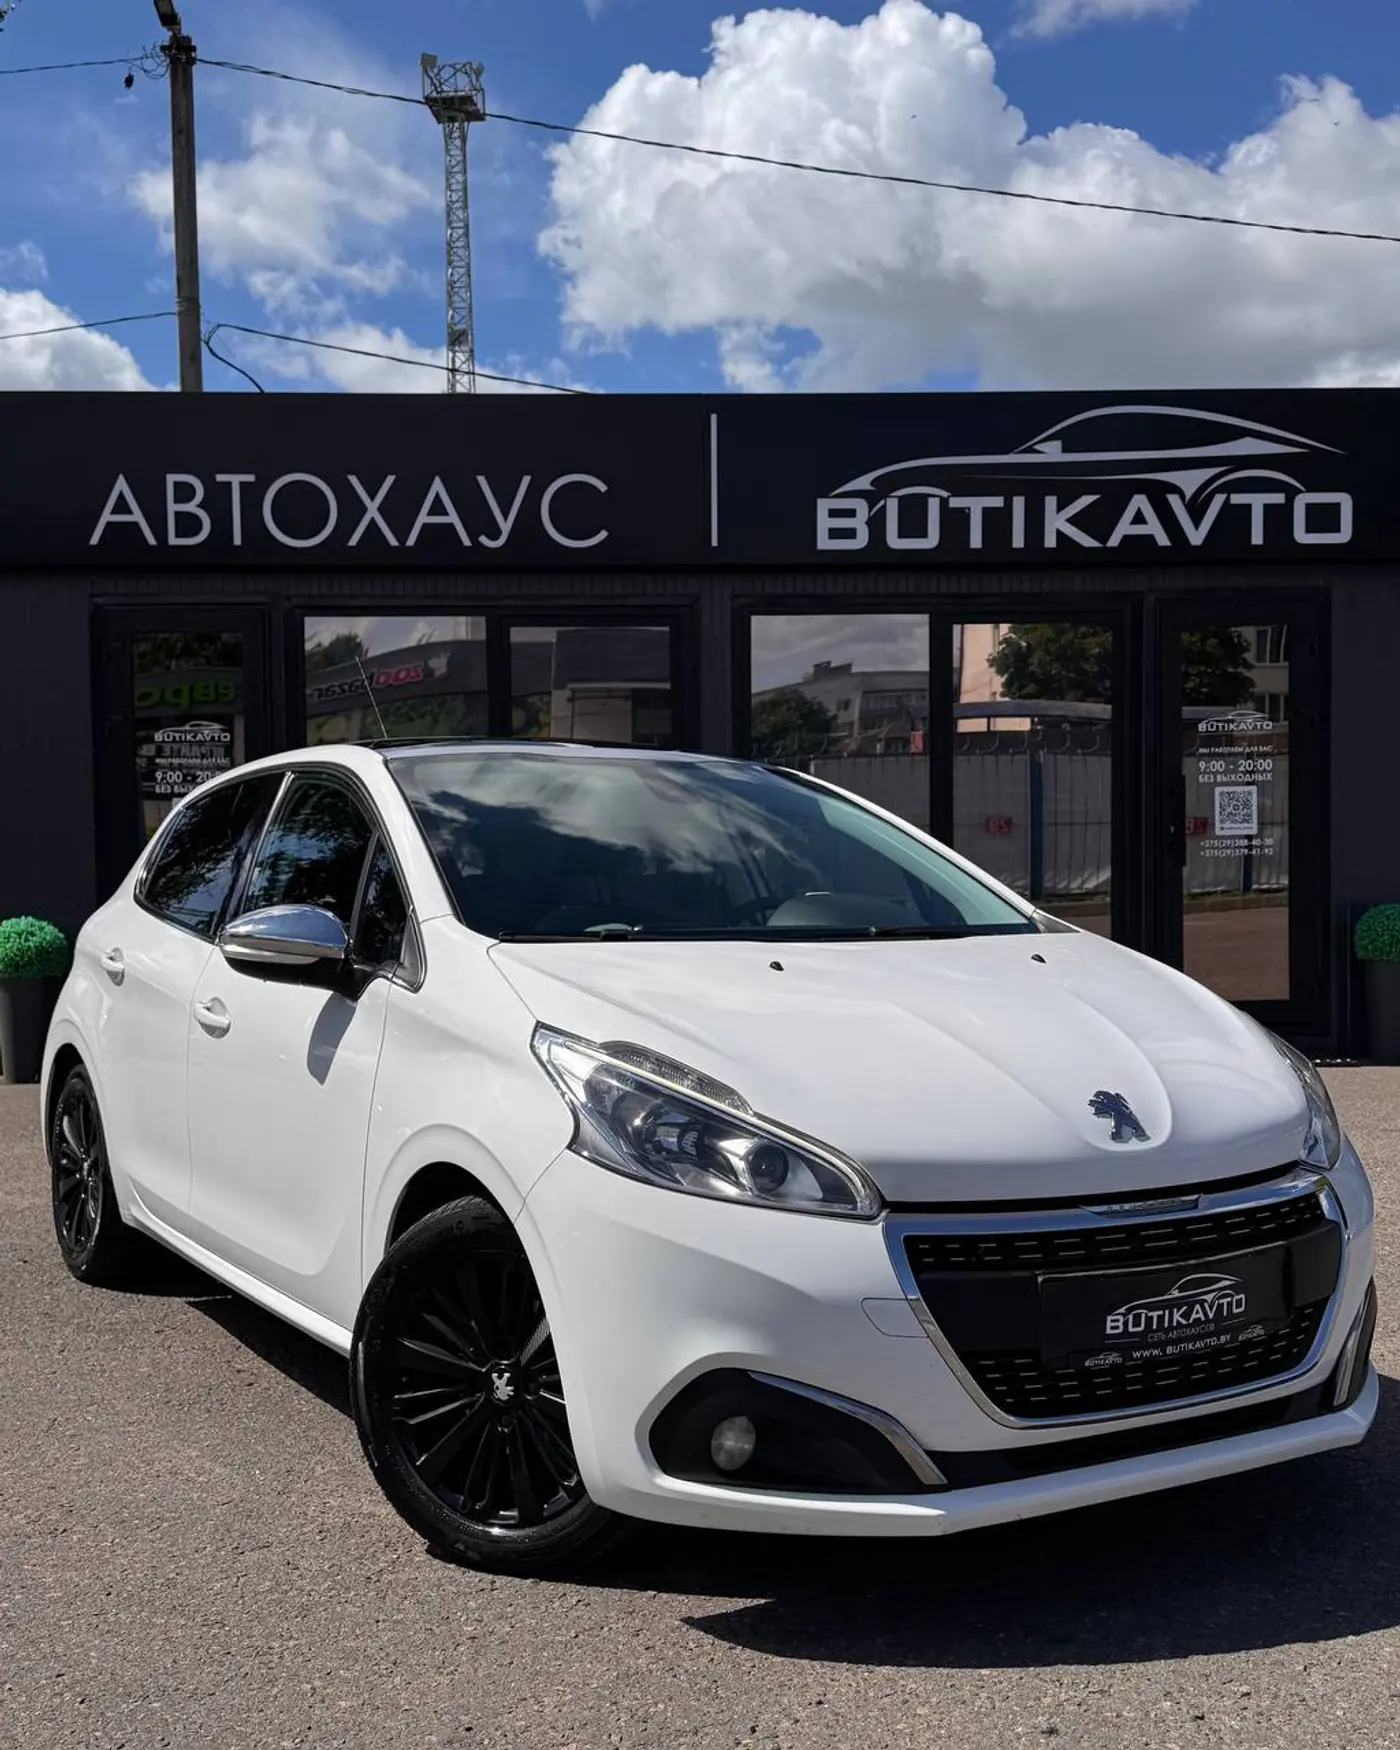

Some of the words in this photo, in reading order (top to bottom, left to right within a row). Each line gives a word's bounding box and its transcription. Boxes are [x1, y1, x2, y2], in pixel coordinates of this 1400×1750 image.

[88, 472, 610, 549] АВТОХАУС
[815, 491, 1354, 552] BUTIKAVTO
[1198, 721, 1273, 732] BUTIKAVTO
[154, 732, 231, 742] BUTIKAVTO
[1199, 760, 1225, 772] 9:00
[1238, 759, 1272, 771] 20:00
[155, 771, 183, 783] 9:00
[1198, 773, 1214, 783] БЕЗ
[1216, 772, 1273, 783] ВЫХОДНЫХ
[1105, 1293, 1246, 1335] BUTIKAVTO
